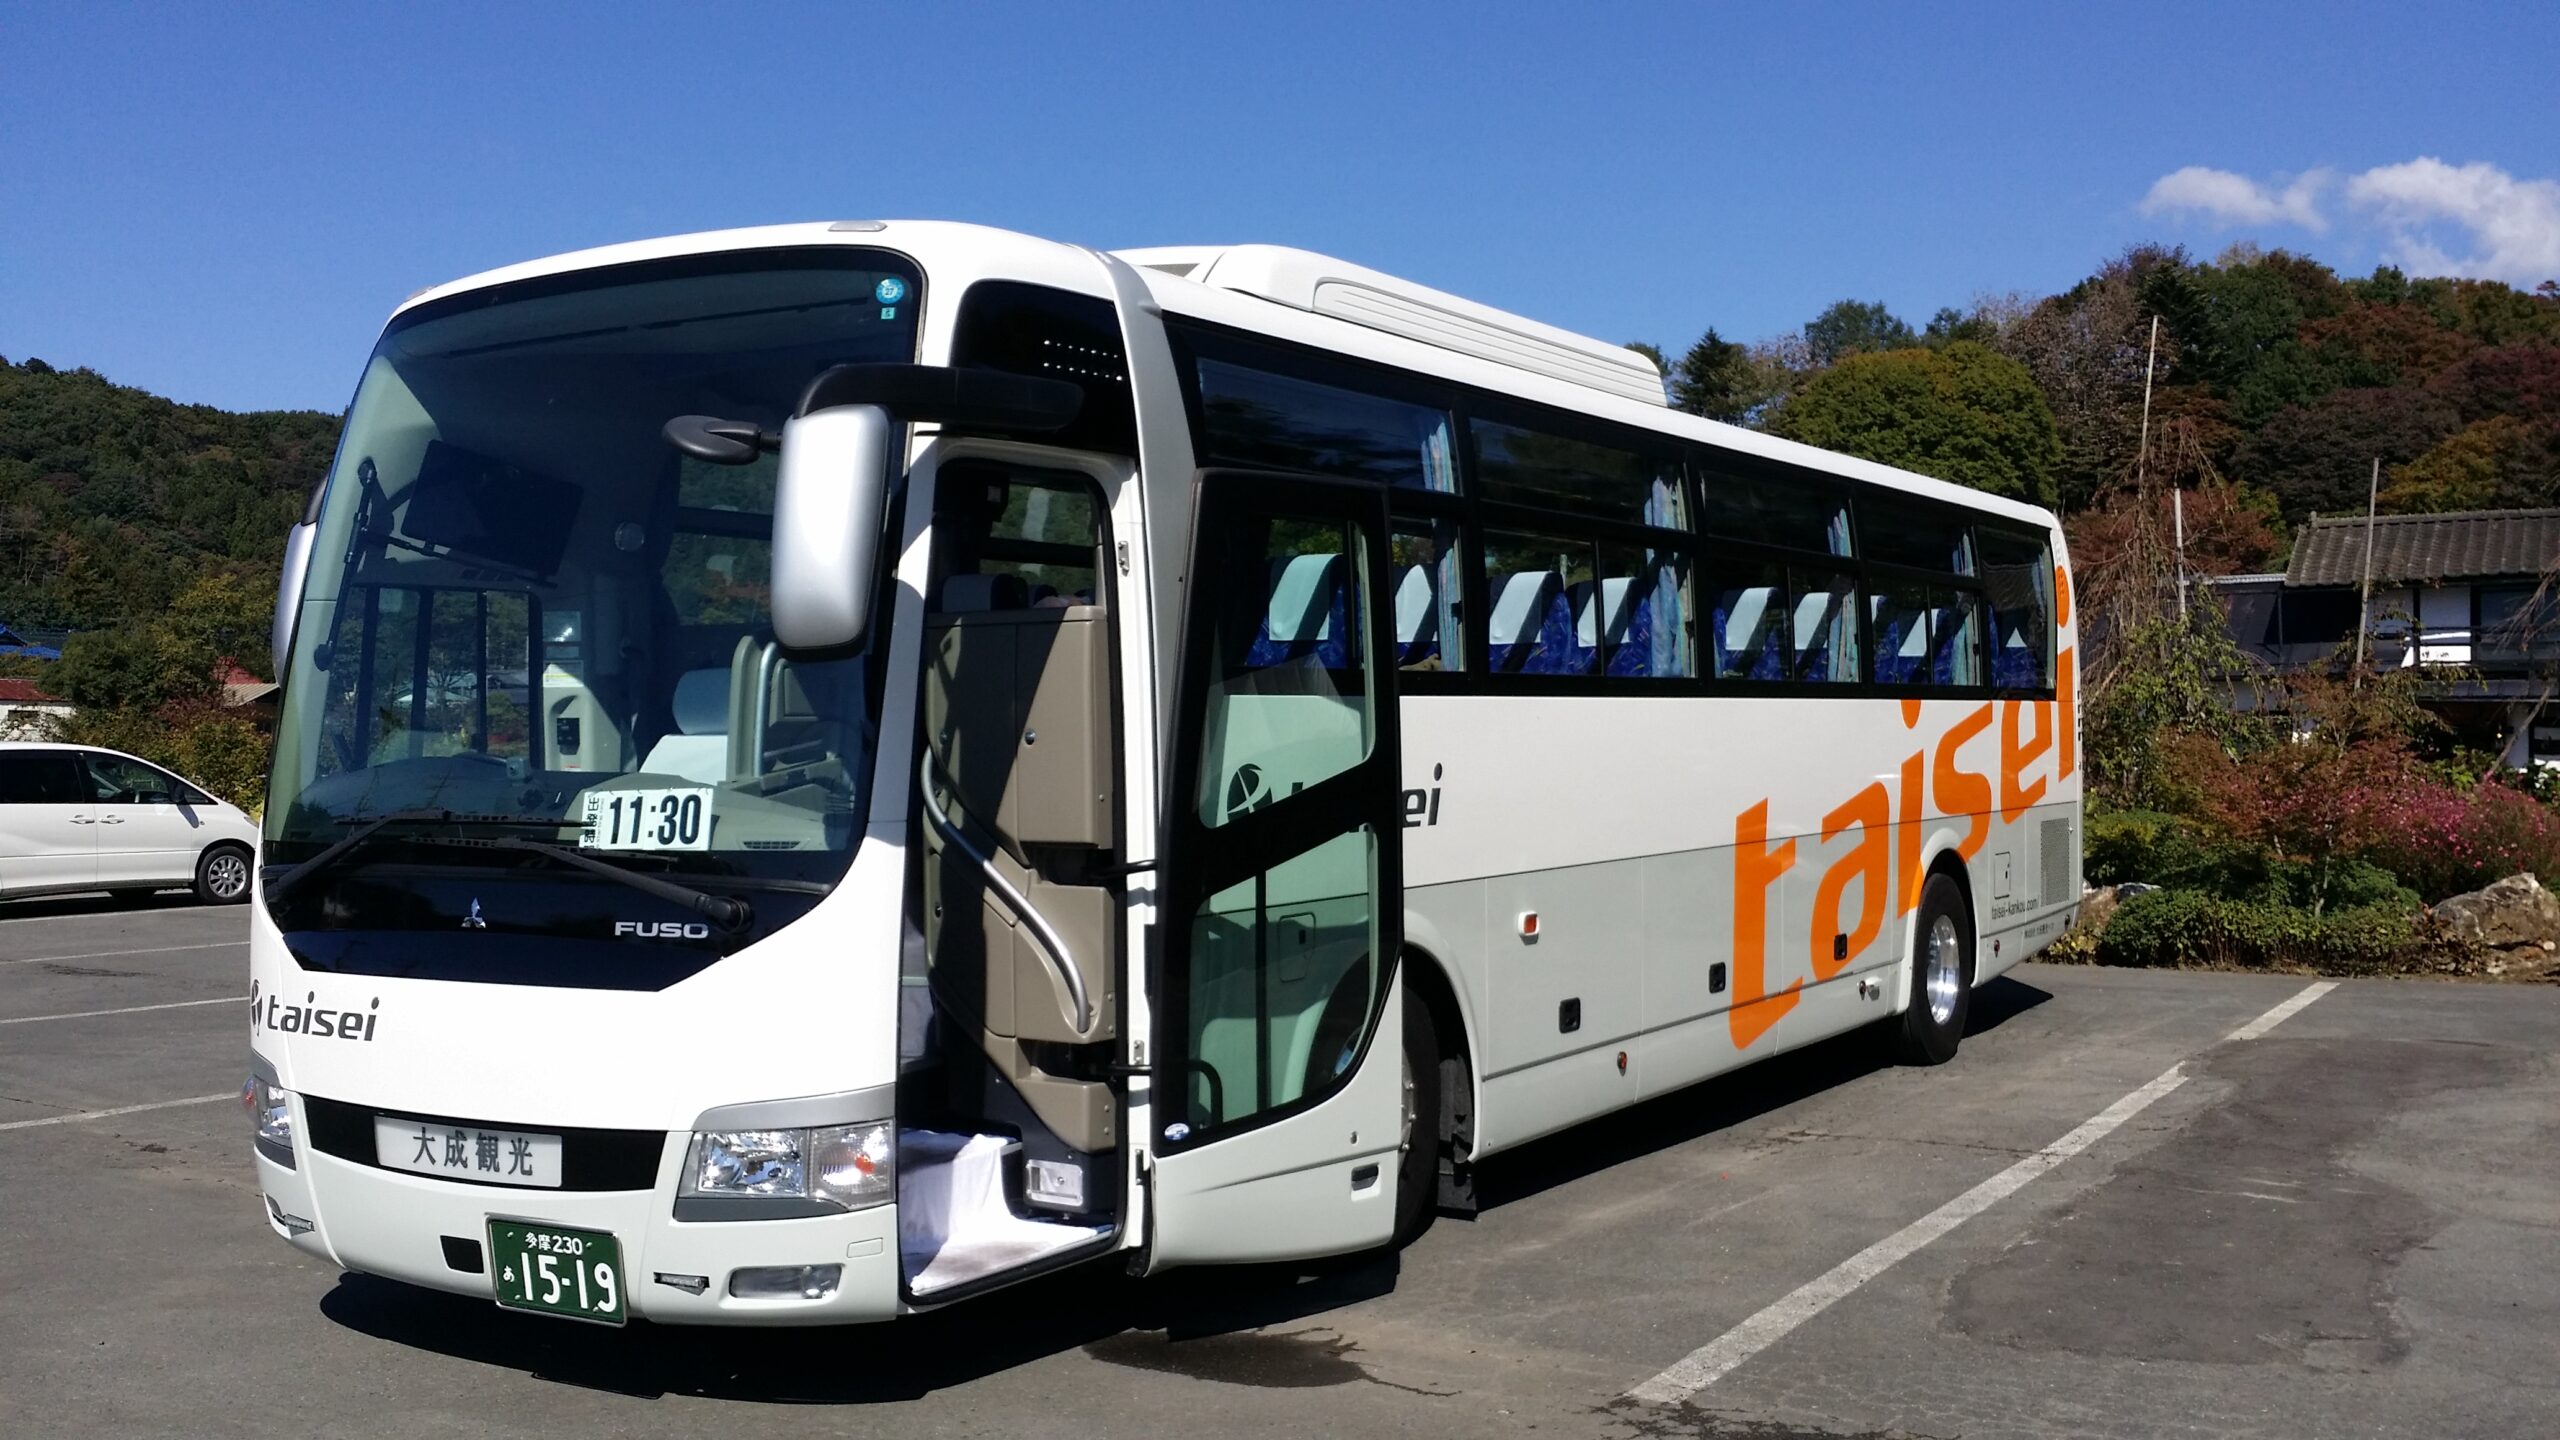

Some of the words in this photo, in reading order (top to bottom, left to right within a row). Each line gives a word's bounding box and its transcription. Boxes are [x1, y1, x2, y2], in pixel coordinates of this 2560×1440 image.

[609, 794, 701, 845] 11:30
[1730, 566, 2074, 1050] taisei
[614, 921, 709, 939] FUSO
[267, 990, 380, 1042] taisei
[412, 1126, 533, 1176] 大成観光
[503, 1265, 515, 1283] あ
[521, 1252, 617, 1313] 15-19
